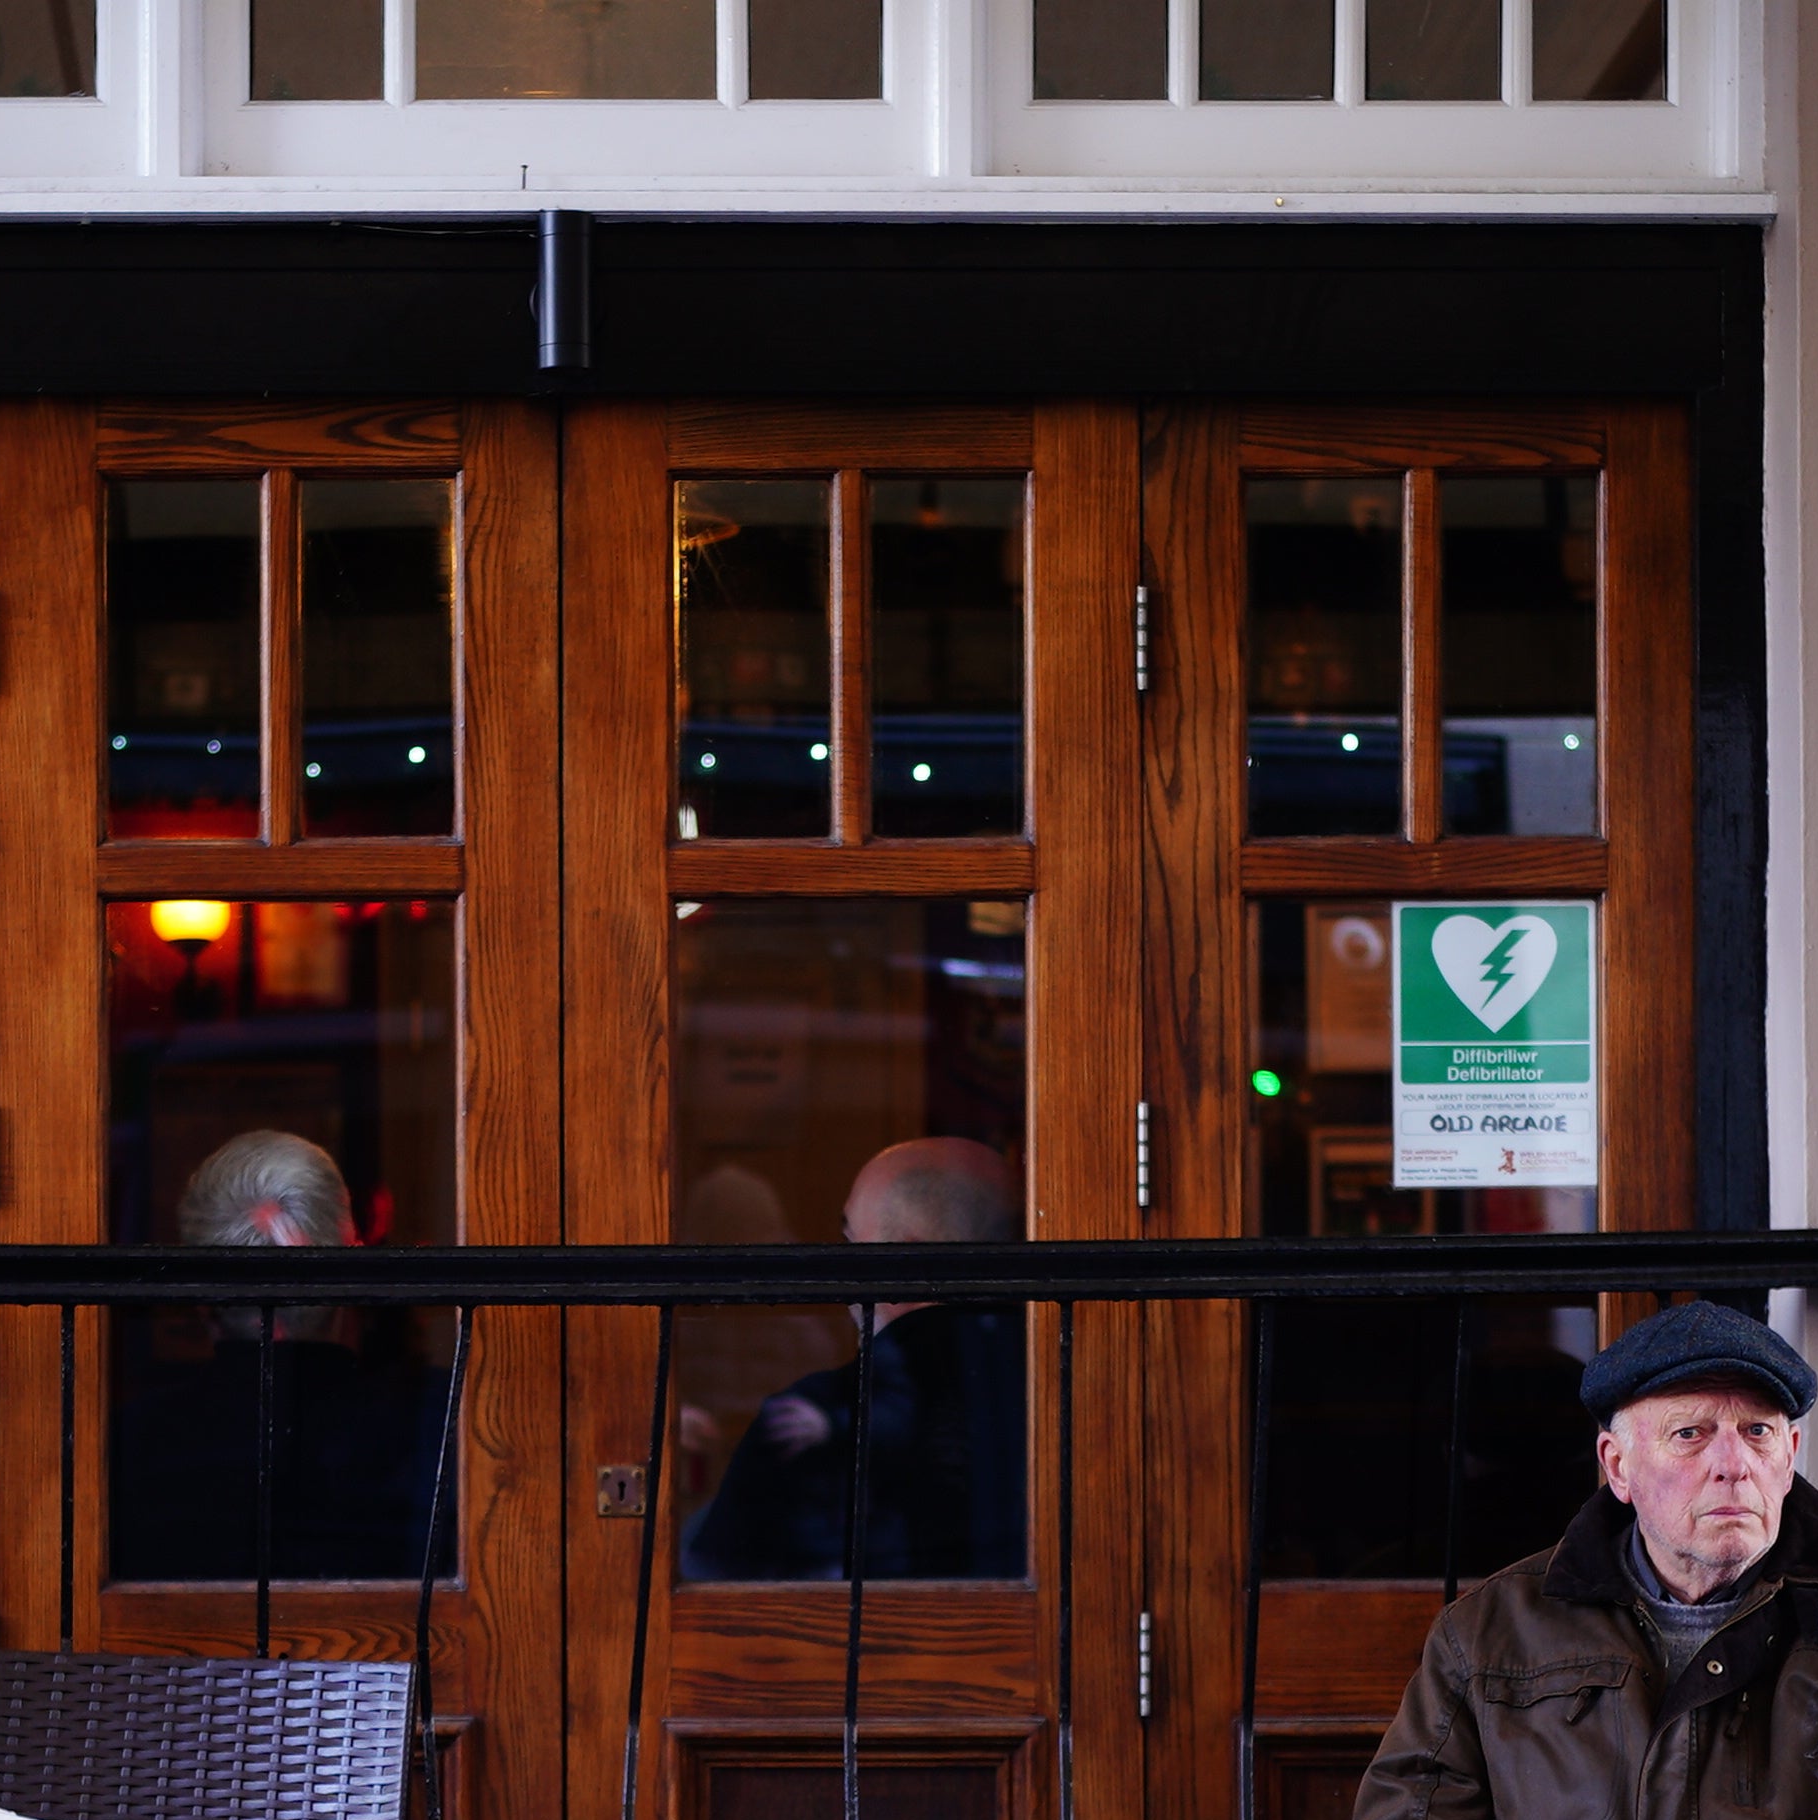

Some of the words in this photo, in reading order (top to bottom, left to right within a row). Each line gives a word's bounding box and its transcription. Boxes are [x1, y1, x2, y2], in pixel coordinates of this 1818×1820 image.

[1452, 1048, 1538, 1064] Diffibriliwr
[1447, 1066, 1544, 1081] Defibrillator
[1430, 1114, 1474, 1133] OLD
[1480, 1114, 1568, 1134] ARCADE
